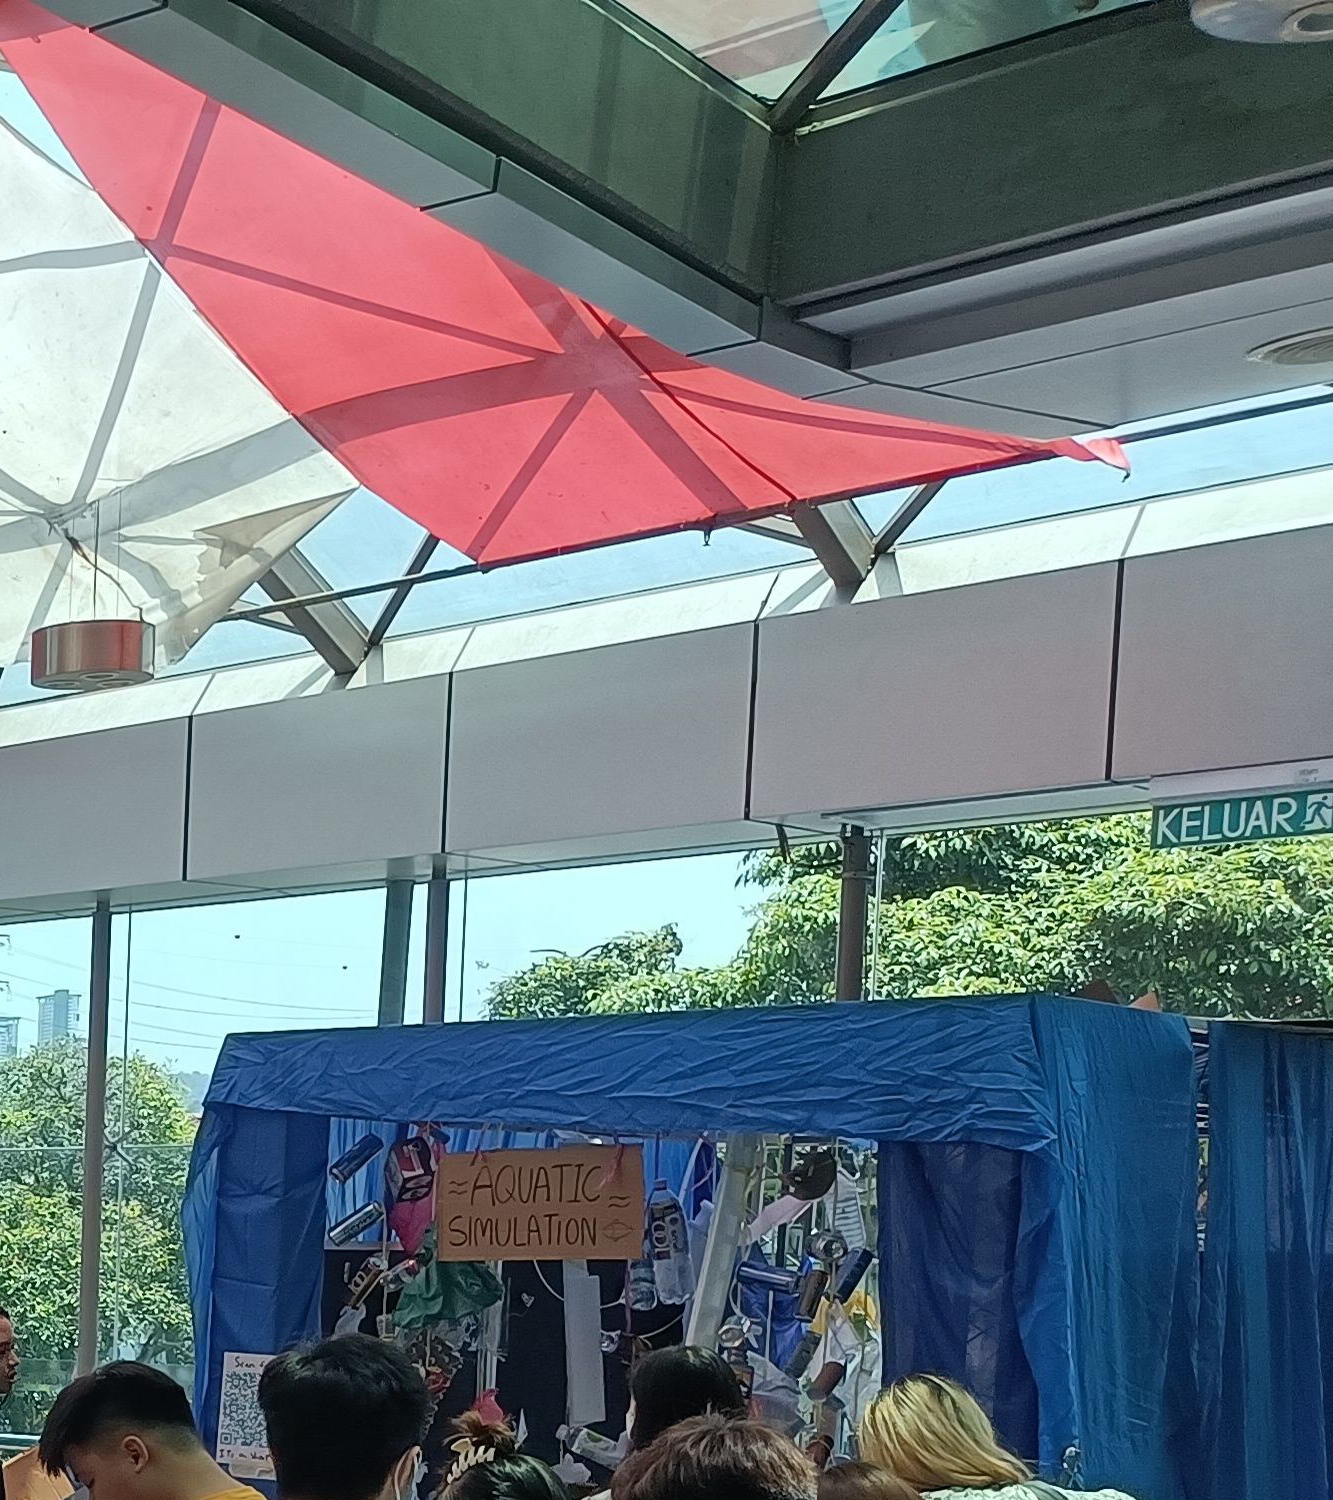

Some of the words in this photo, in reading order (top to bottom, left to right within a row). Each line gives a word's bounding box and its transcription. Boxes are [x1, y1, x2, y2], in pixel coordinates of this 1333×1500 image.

[1155, 797, 1298, 846] KELUAR
[470, 1163, 602, 1207] AQUATIC
[448, 1213, 597, 1247] SIMULATION
